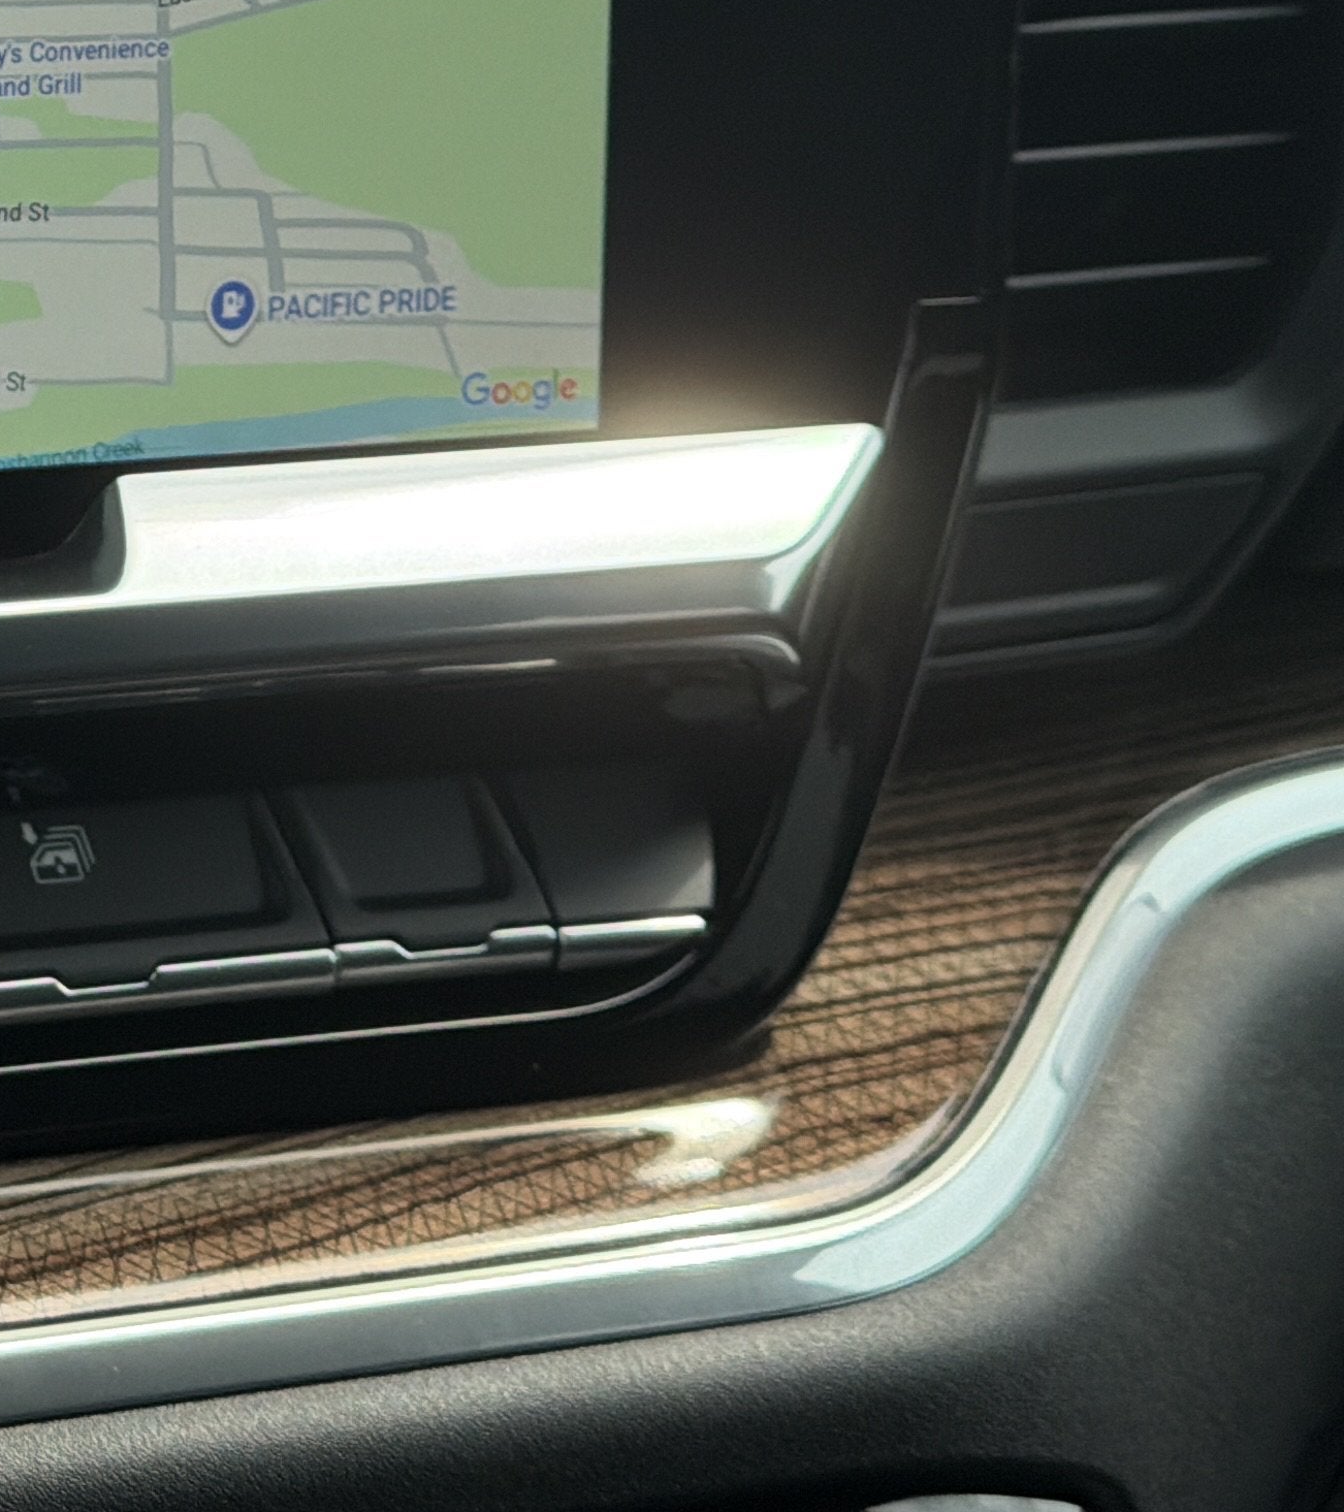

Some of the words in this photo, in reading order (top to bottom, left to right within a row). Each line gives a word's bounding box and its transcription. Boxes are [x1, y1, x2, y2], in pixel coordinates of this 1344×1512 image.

[29, 39, 170, 63] Convenience
[37, 72, 83, 96] Grill
[27, 201, 50, 224] St
[267, 291, 372, 320] PACIFIC
[378, 287, 458, 316] PRIDE
[6, 371, 26, 392] St
[462, 368, 579, 412] Google
[93, 437, 145, 461] Creek
